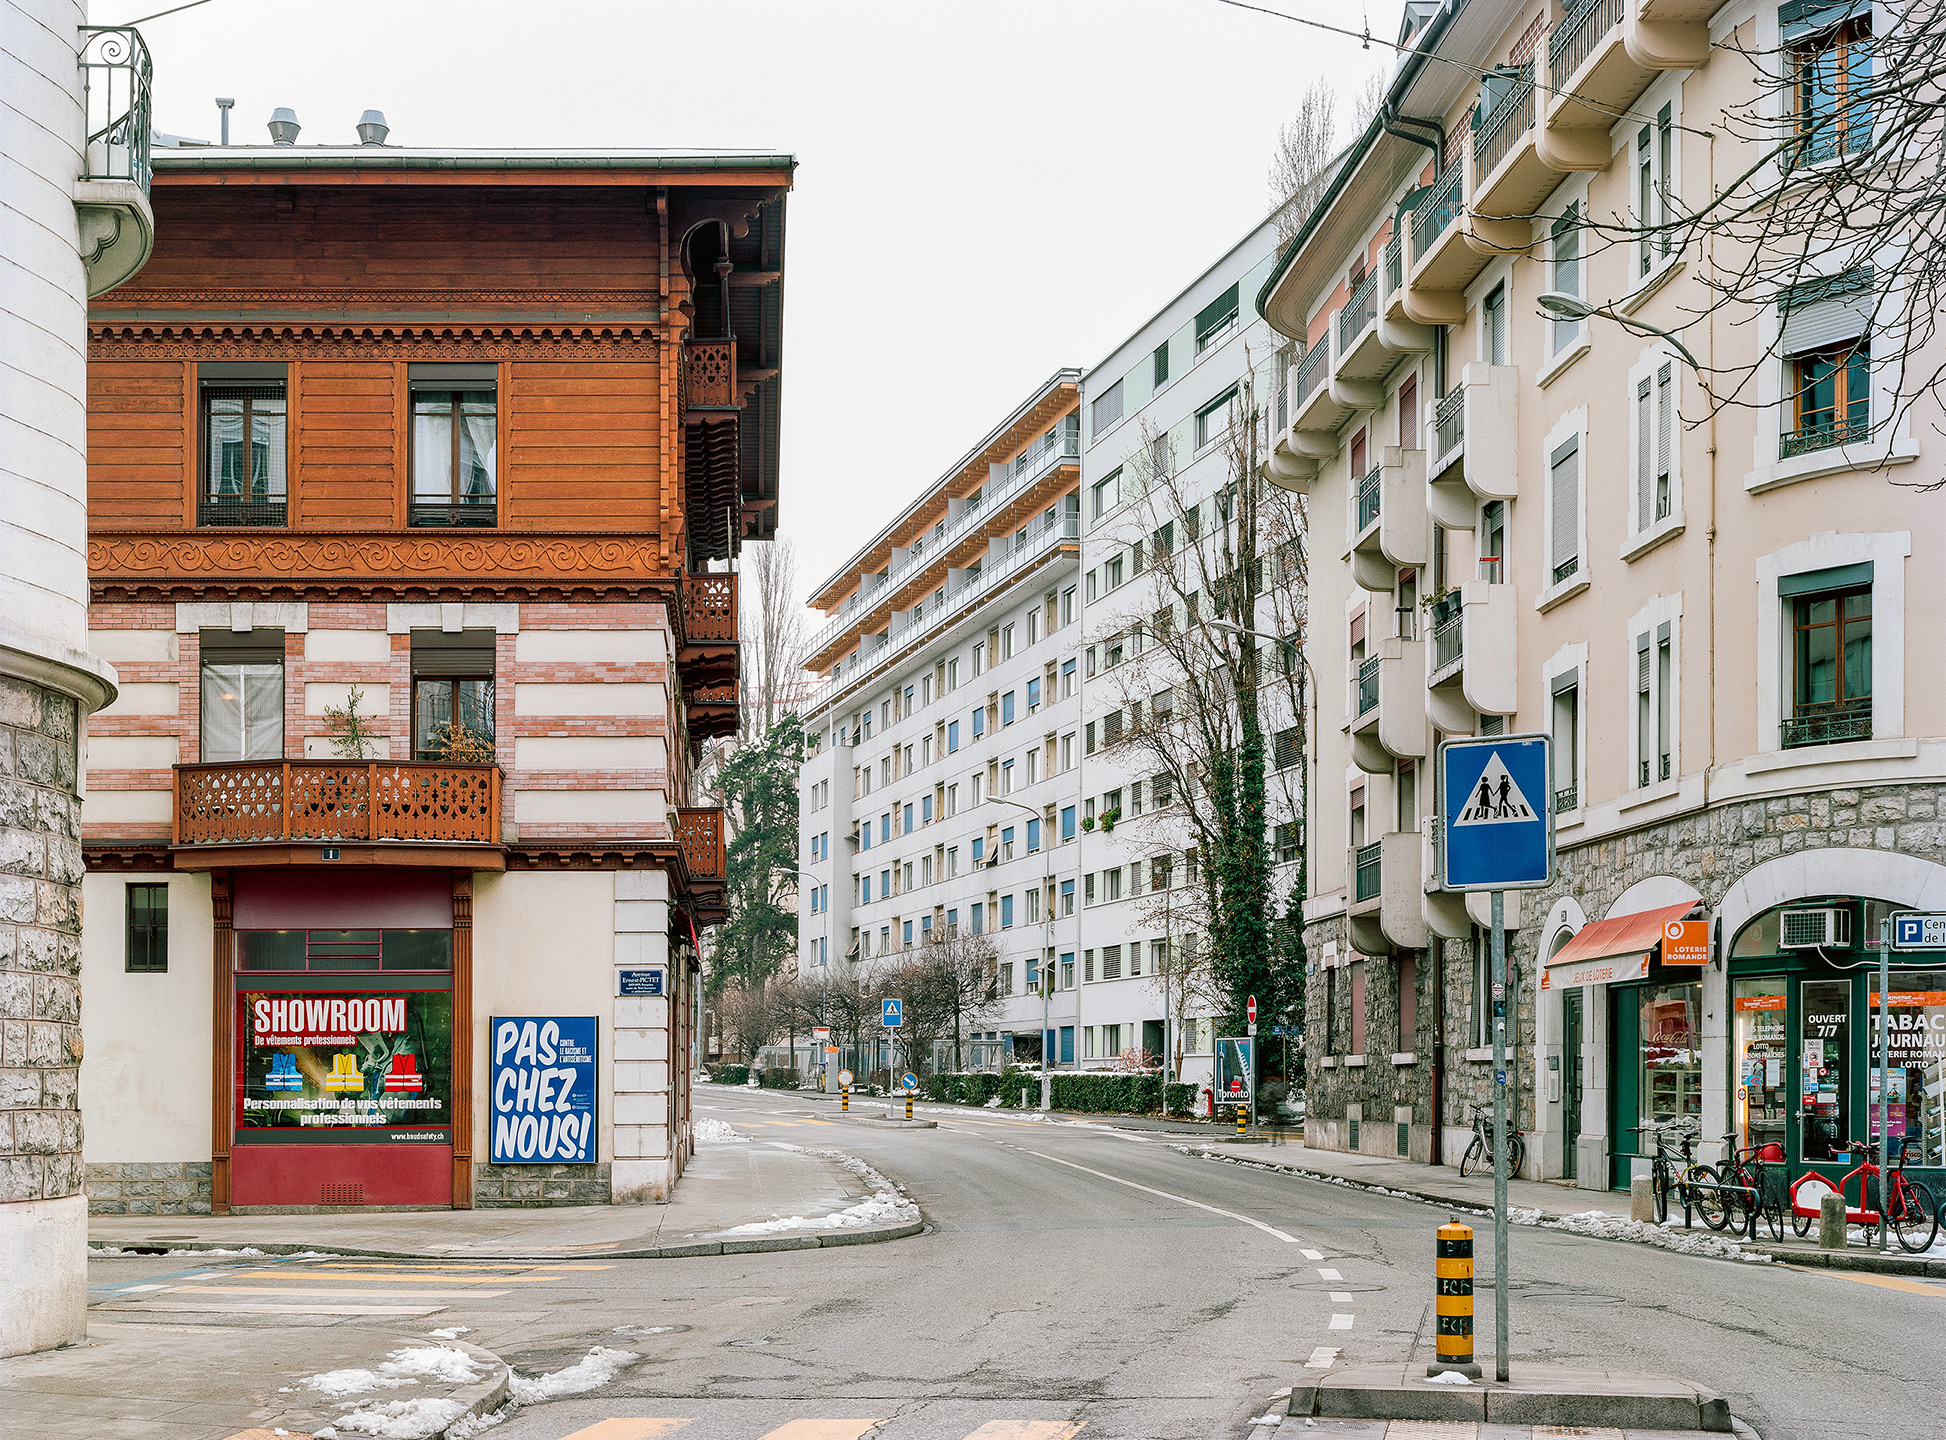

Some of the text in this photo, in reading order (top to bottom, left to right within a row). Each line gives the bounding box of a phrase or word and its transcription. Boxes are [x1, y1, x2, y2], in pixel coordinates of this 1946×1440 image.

[328, 849, 333, 859] 1
[1924, 933, 1938, 943] de
[1585, 970, 1593, 982] DE
[1592, 967, 1613, 981] LOTERIE
[254, 998, 405, 1032] SHOWROOM
[1808, 1014, 1847, 1023] OUVERT
[1871, 1014, 1946, 1030] TABAC
[1816, 1025, 1838, 1037] 7/7
[255, 1034, 356, 1047] De vêtements professionnels
[495, 1020, 560, 1066] PAS
[1900, 1060, 1929, 1068] LOTTO
[495, 1067, 578, 1113] CHEZ
[1217, 1089, 1249, 1098] Toronto
[243, 1096, 442, 1110] Personnalisation de vos vêtements
[300, 1112, 387, 1126] professionnels
[495, 1111, 591, 1160] NOUS!
